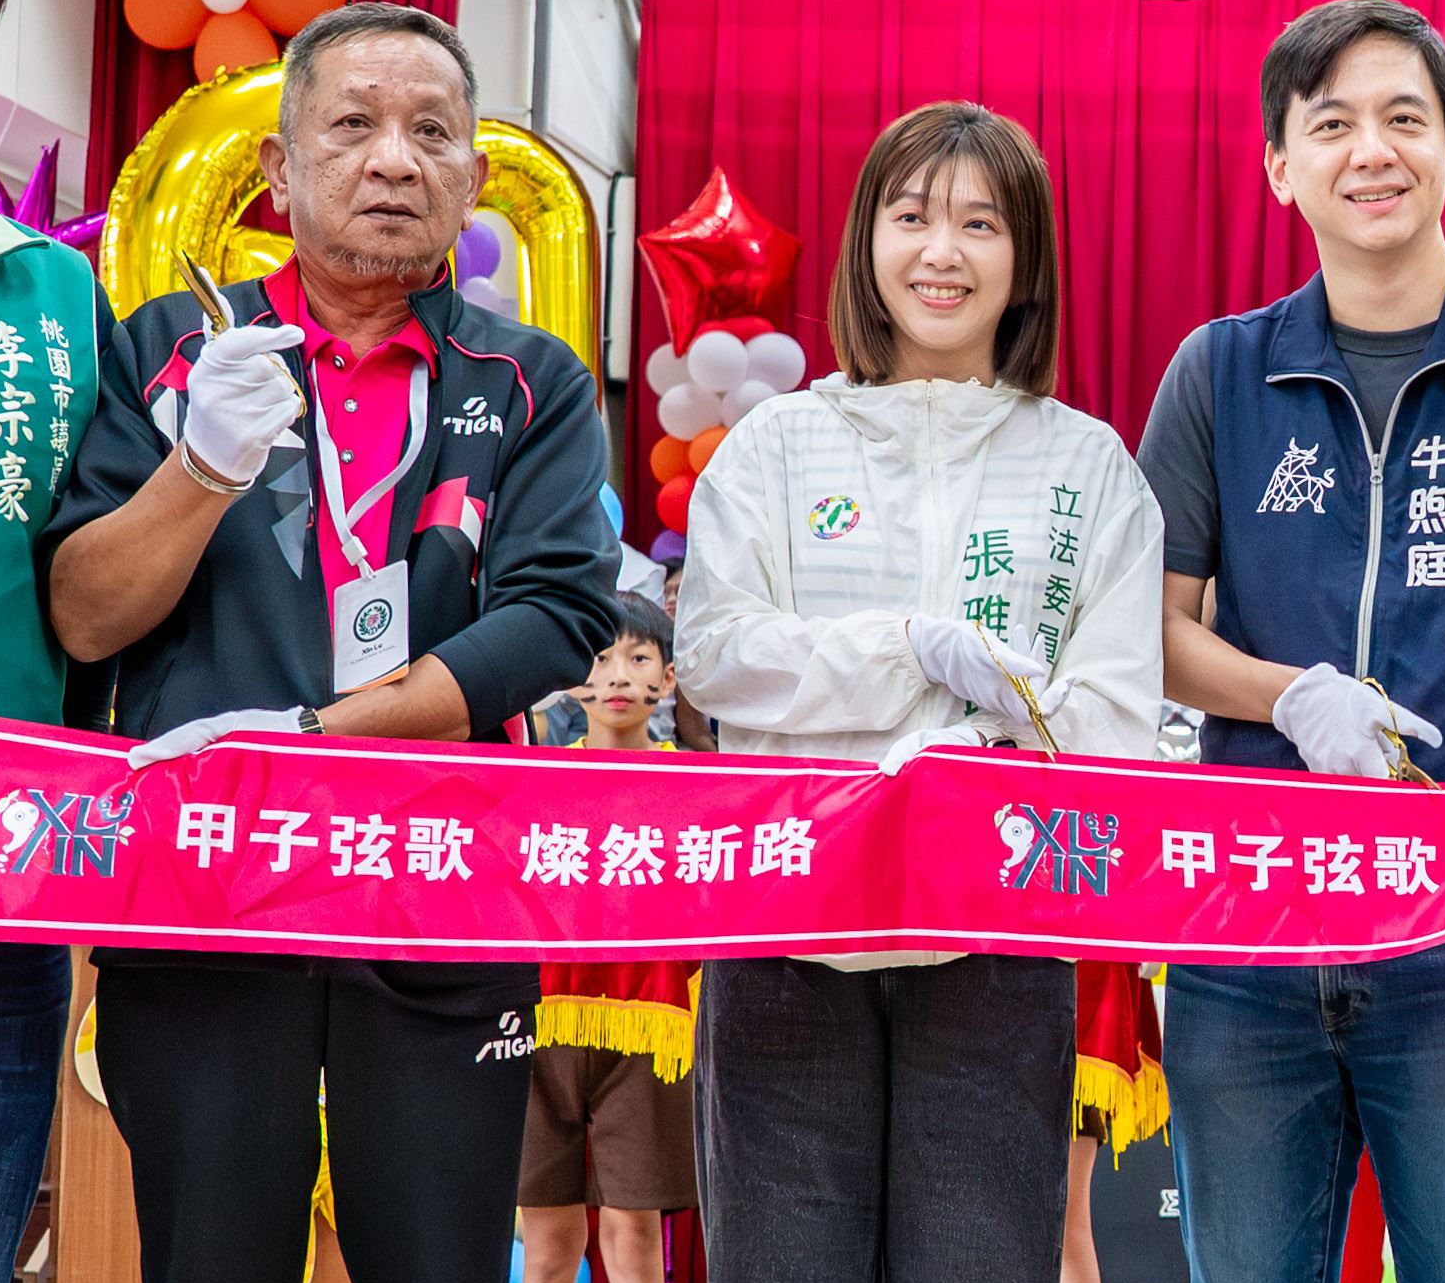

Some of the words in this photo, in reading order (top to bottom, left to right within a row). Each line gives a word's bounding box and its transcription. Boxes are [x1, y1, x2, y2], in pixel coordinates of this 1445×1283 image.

[176, 802, 475, 884] 甲子弦歌
[519, 816, 818, 887] 燦然新路
[1160, 828, 1440, 896] 甲子弦歌
